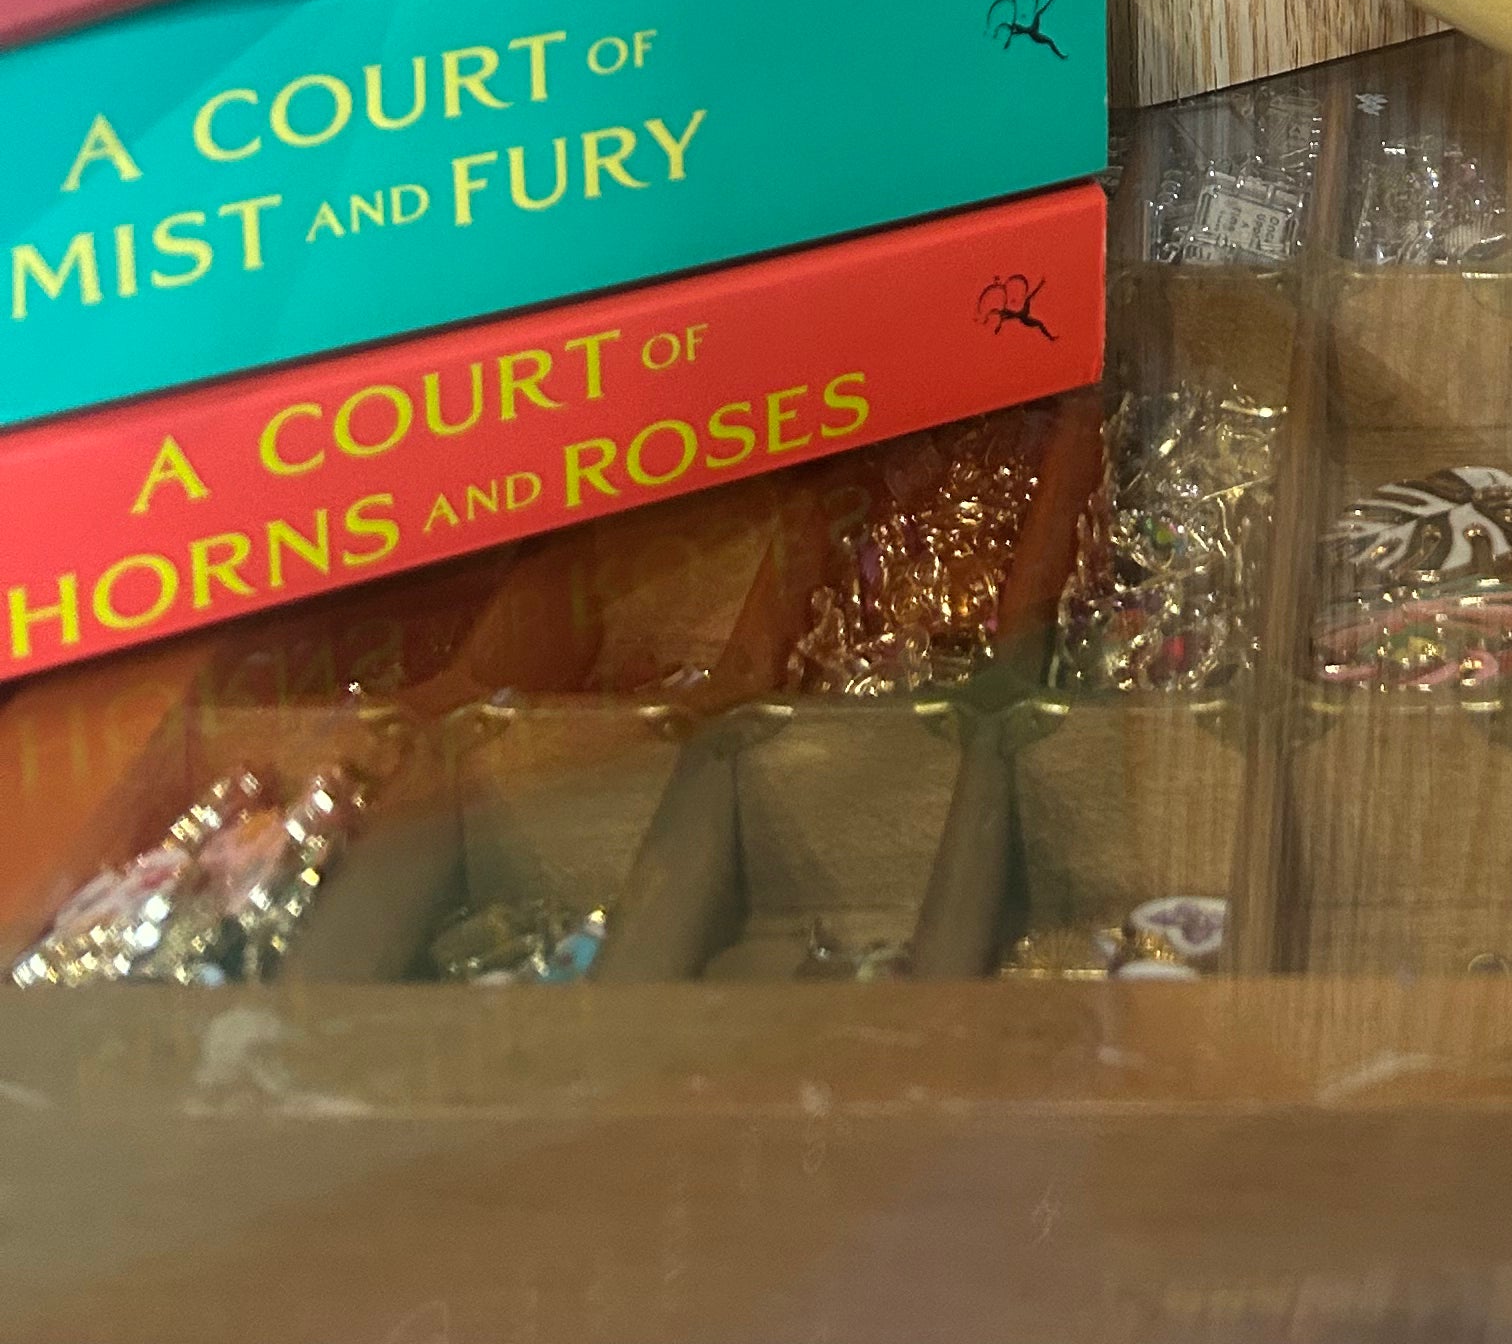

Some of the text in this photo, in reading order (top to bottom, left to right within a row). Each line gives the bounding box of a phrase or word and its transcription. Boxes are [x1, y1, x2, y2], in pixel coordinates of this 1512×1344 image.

[60, 28, 660, 193] A COURT OF
[9, 108, 709, 317] MIST AND FURY
[6, 372, 872, 661] HORNS AND ROSES
[130, 323, 711, 514] A COURT OF
